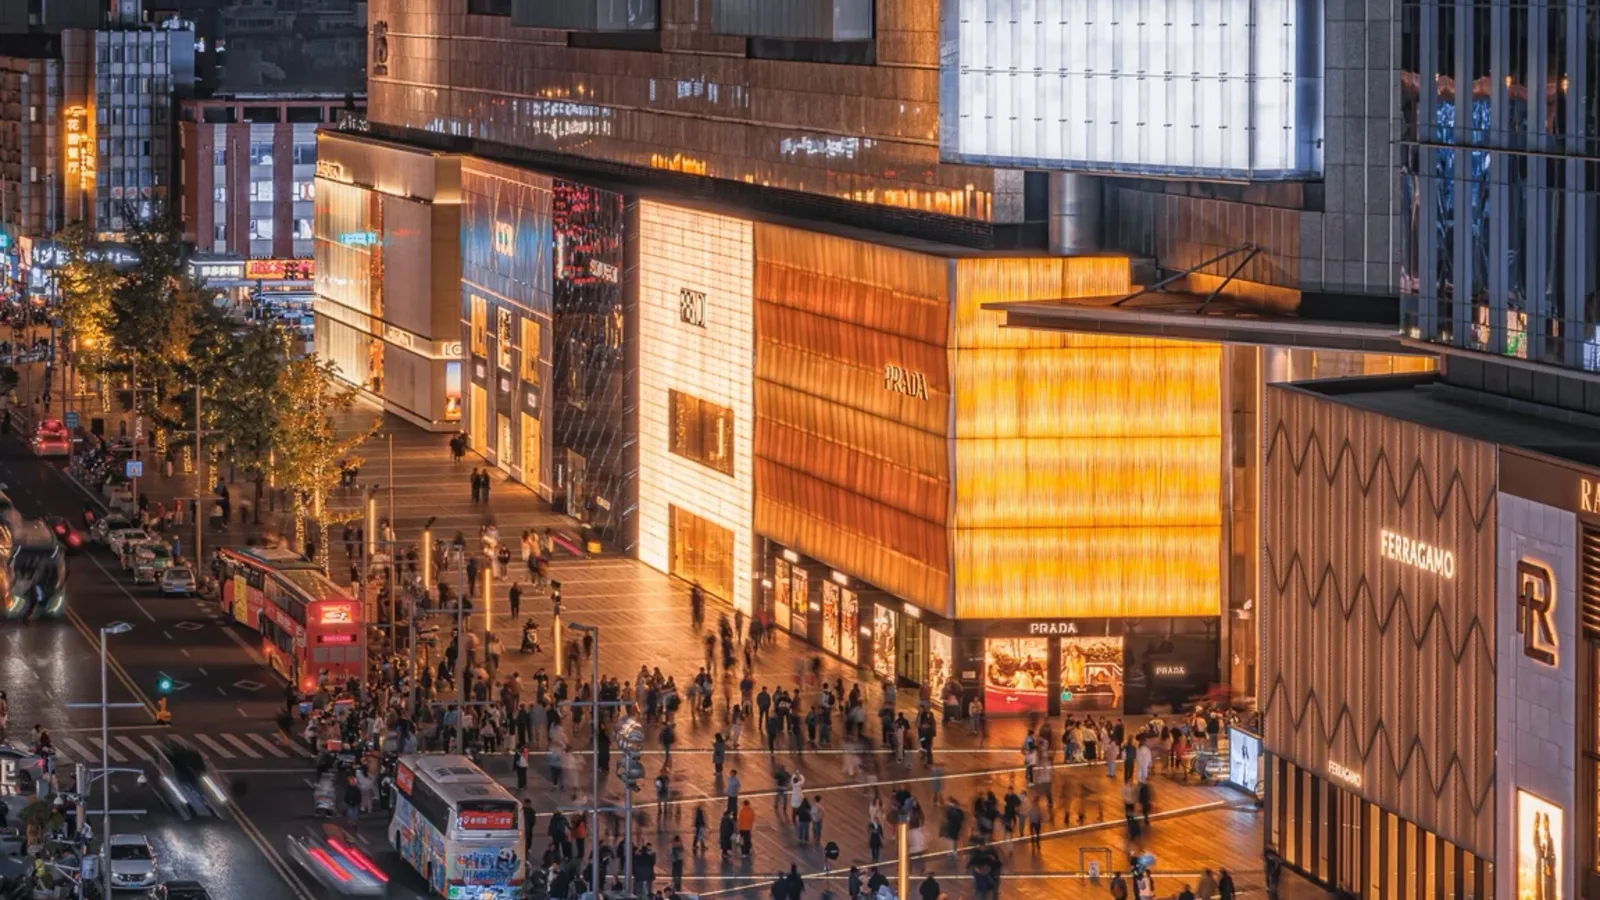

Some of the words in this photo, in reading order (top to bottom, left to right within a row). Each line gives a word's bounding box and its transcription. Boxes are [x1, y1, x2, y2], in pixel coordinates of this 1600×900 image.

[884, 364, 929, 401] PRADA
[1381, 529, 1455, 579] FERRAGAMO
[1029, 622, 1079, 635] PRADA
[1155, 666, 1186, 675] PRADA
